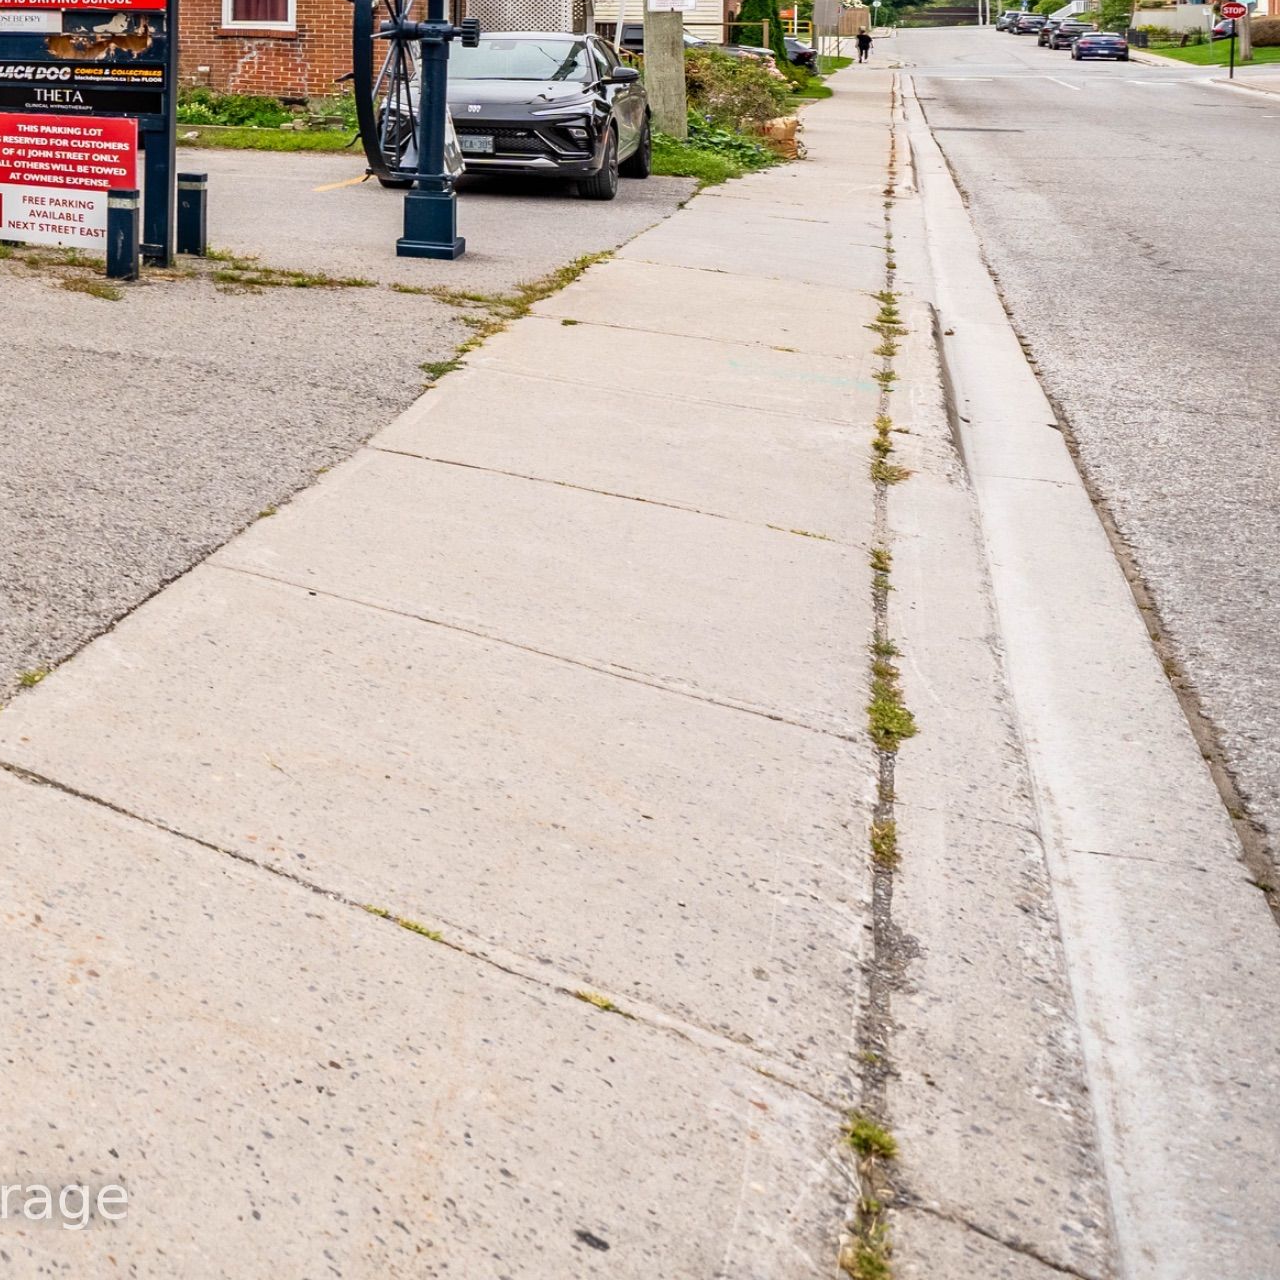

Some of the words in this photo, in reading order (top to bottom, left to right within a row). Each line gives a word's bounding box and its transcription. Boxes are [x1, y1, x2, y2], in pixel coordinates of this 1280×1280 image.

[36, 66, 71, 81] DOG
[34, 88, 84, 103] THETA
[50, 103, 93, 111] HYPNOTHERAPY
[17, 124, 39, 132] THIS
[40, 125, 81, 136] PARKING
[83, 128, 103, 137] LOT
[3, 136, 48, 146] RESERVED
[50, 138, 69, 147] FOR
[70, 140, 130, 150] CUSTOMERS
[2, 148, 15, 156] OF
[16, 149, 25, 157] 41
[27, 149, 53, 158] JOHN
[55, 152, 90, 161] STREET
[92, 154, 120, 163] ONLY.
[13, 161, 51, 170] OTHERS
[52, 163, 74, 172] WILL
[77, 165, 90, 173] BE
[91, 166, 127, 176] TOWED
[9, 172, 21, 180] AT
[23, 174, 64, 184] OWNERS
[66, 177, 111, 187] EXPENSE.
[22, 195, 46, 205] FREE
[49, 198, 94, 210] PARKING
[28, 209, 84, 223] AVAILABLE
[8, 220, 36, 231] NEXT
[38, 223, 76, 235] STREET
[79, 227, 107, 238] EAST
